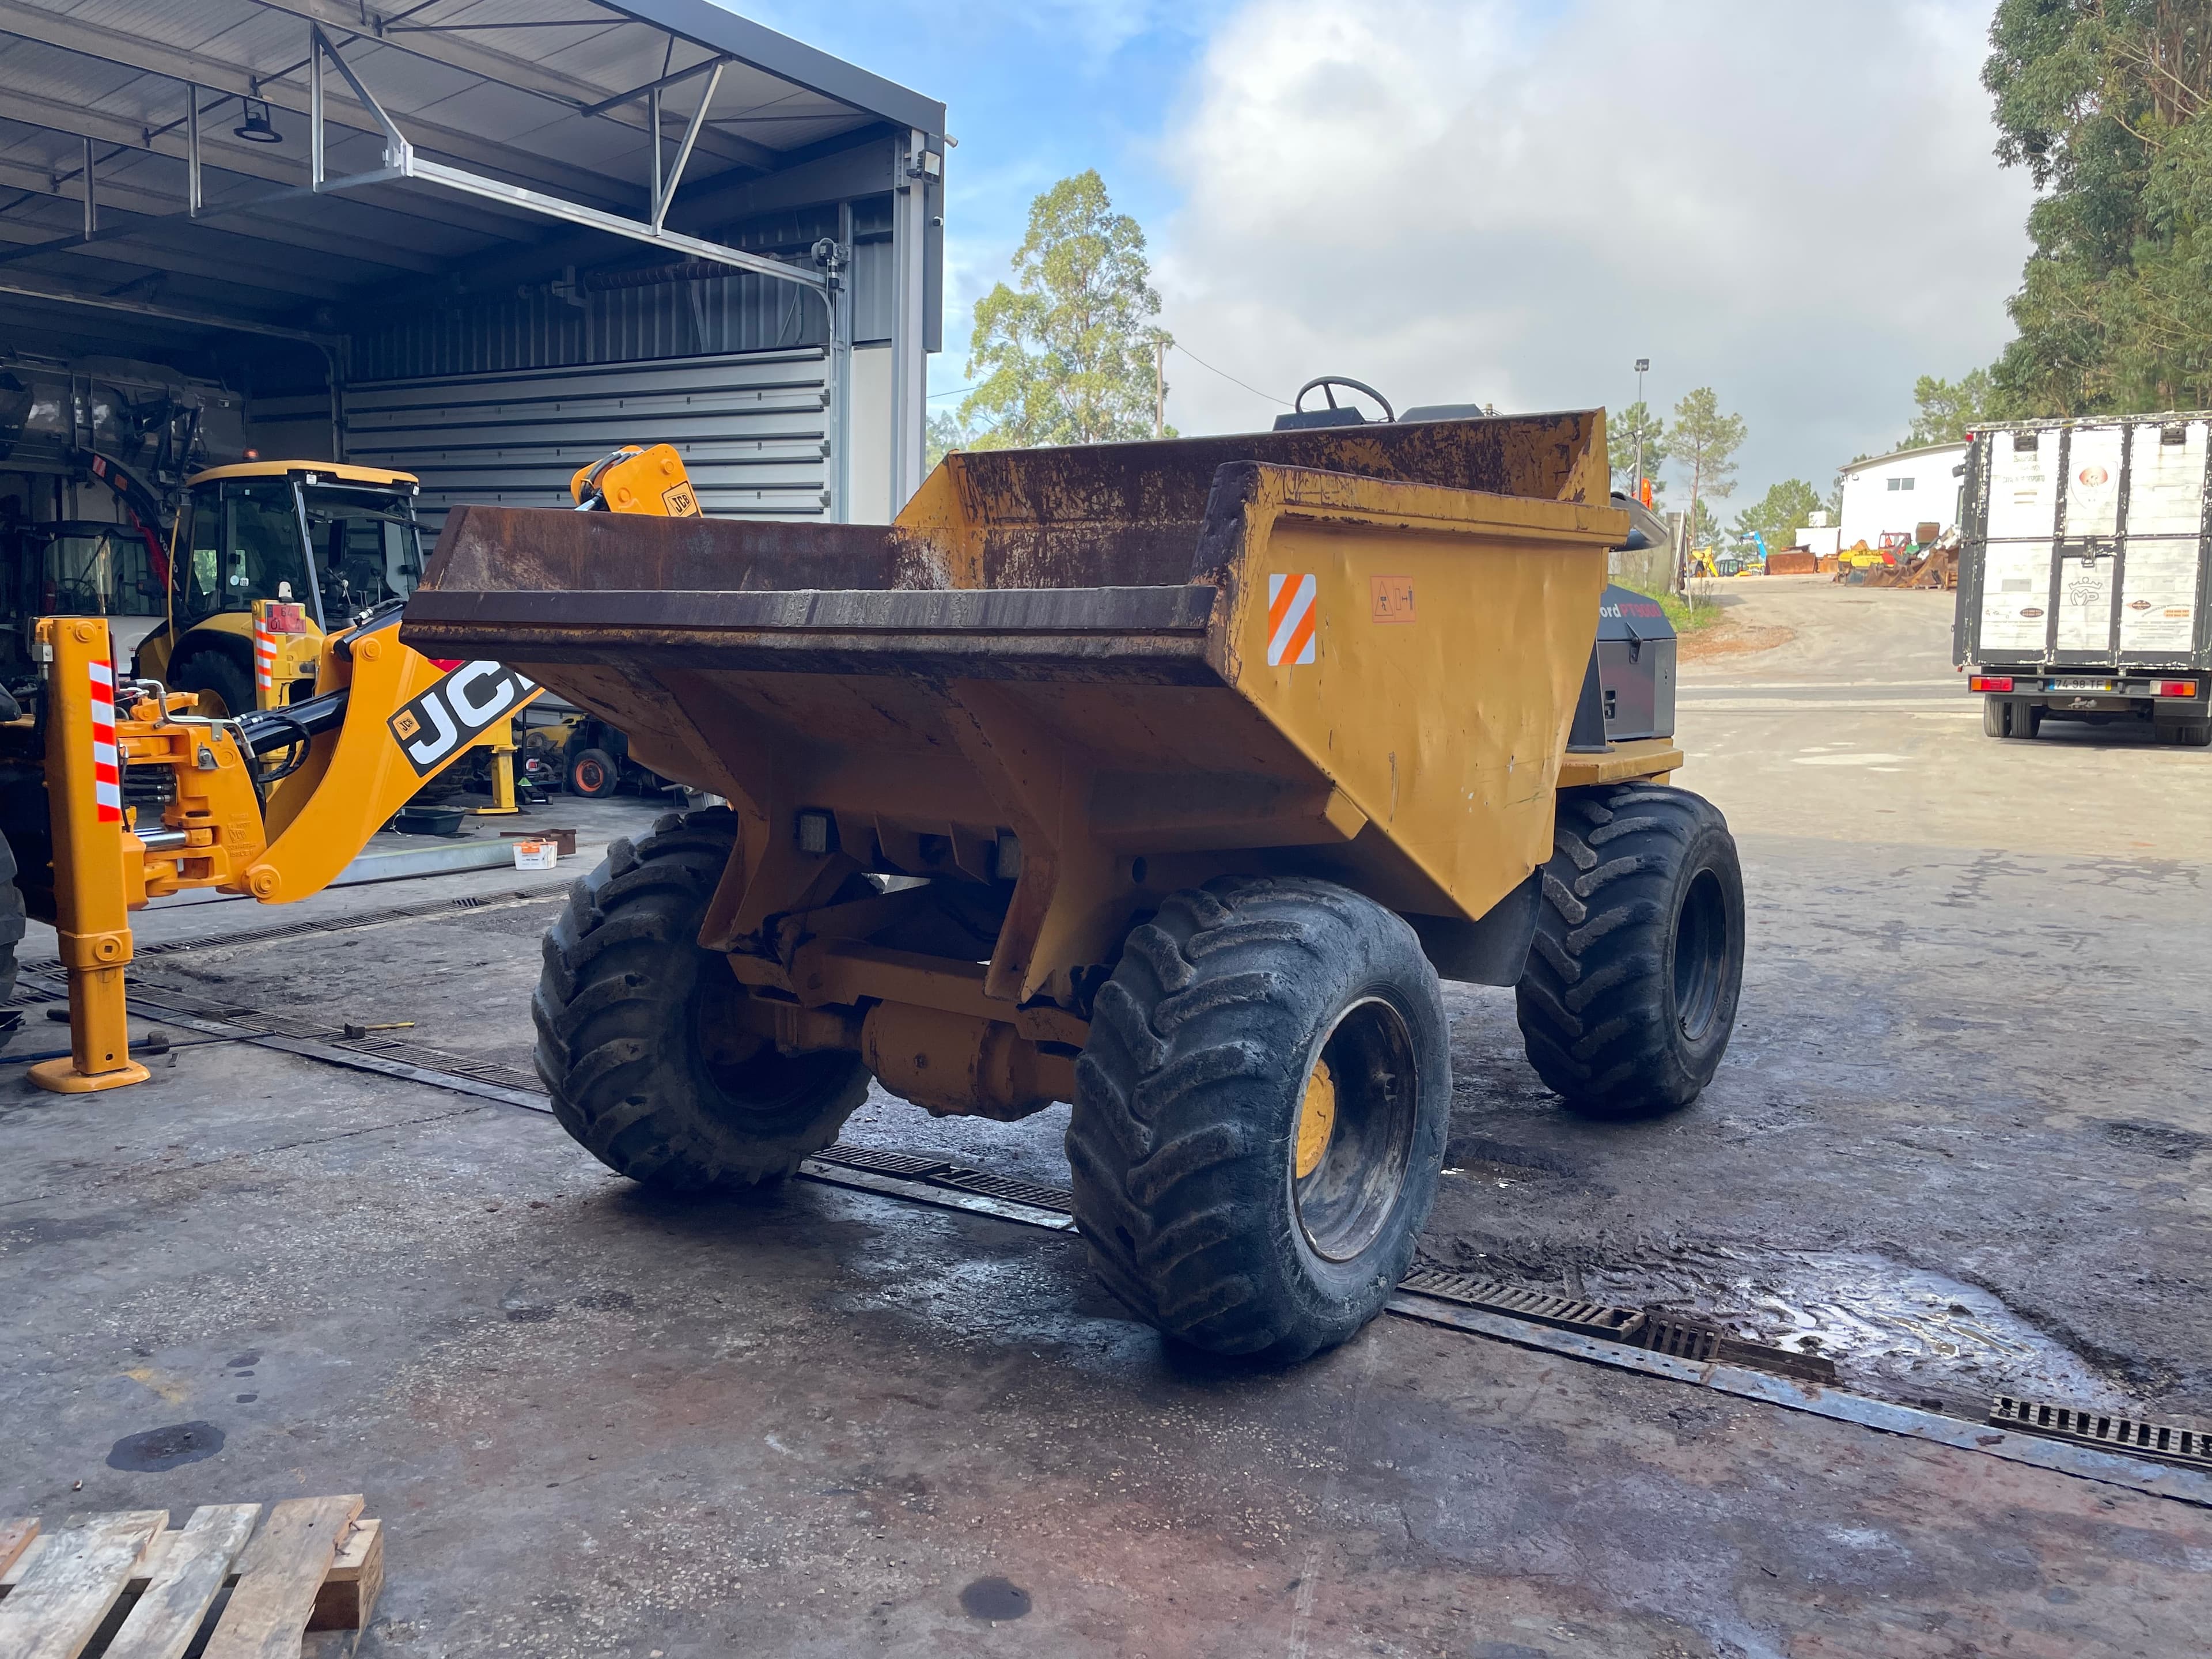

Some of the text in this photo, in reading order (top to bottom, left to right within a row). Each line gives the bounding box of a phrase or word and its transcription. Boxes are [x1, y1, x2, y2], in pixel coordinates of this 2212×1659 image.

[672, 494, 690, 513] JCB
[160, 533, 179, 573] VOLO
[1599, 604, 1622, 618] ord
[408, 660, 535, 765] JC
[399, 719, 413, 732] JCB
